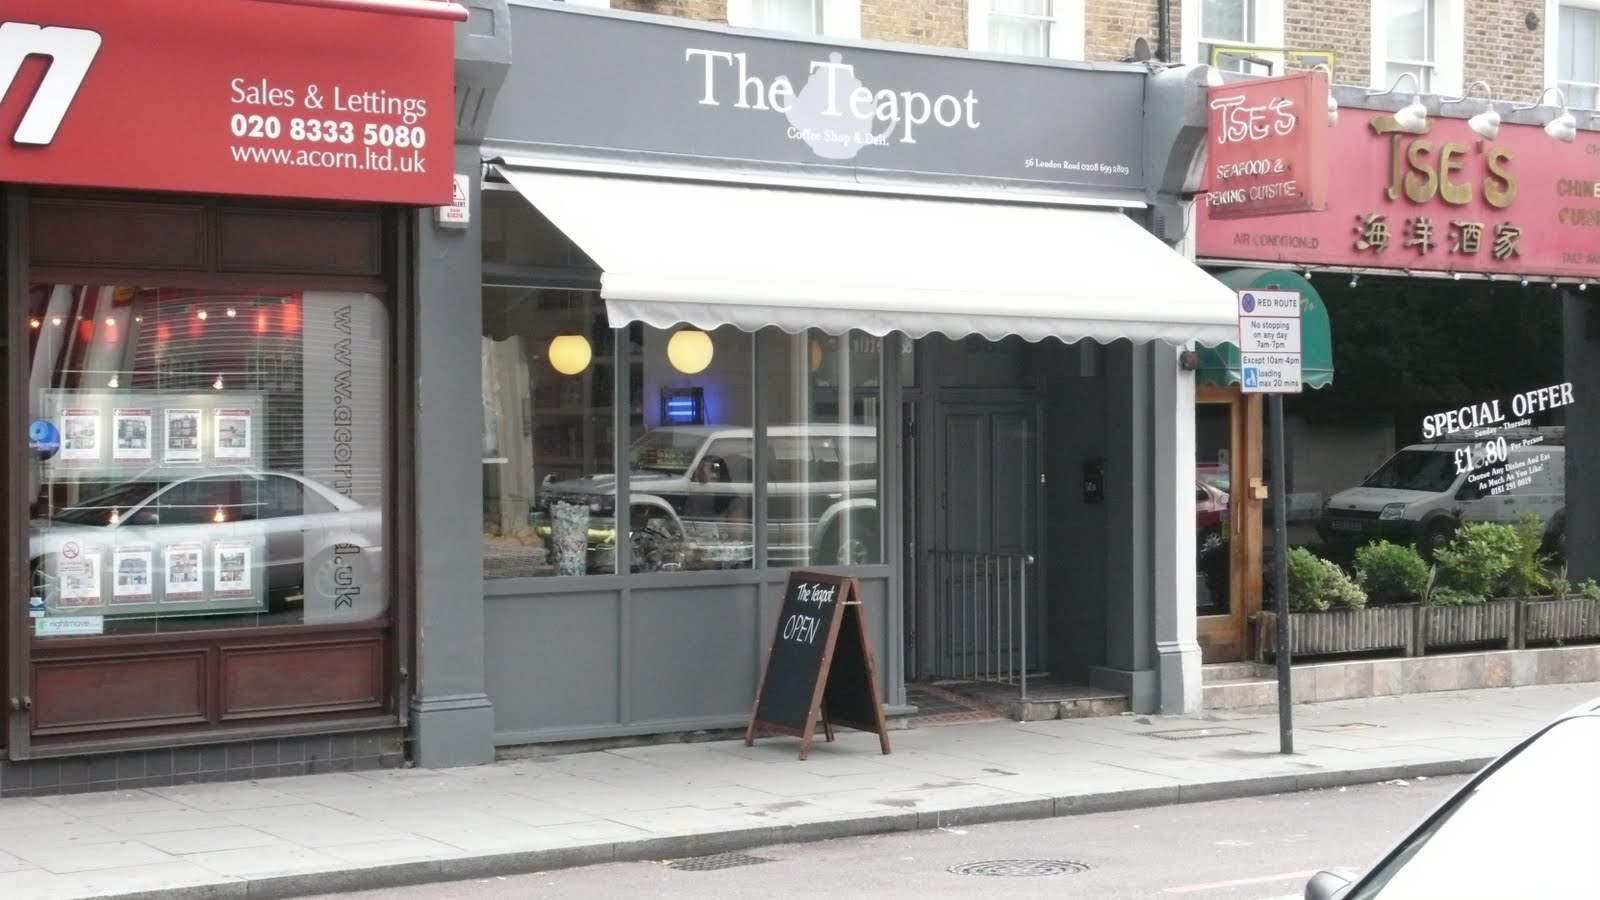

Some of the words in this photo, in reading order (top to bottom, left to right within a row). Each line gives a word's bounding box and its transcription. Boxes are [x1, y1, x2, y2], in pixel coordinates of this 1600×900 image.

[230, 77, 296, 107] Sales
[303, 84, 324, 110] &
[334, 86, 427, 125] Lettings
[685, 47, 793, 114] The
[809, 60, 981, 144] Teapot
[1210, 95, 1296, 144] TSE'S
[230, 113, 282, 140] 020
[289, 117, 355, 144] 8333
[363, 123, 426, 149] 5080
[787, 126, 821, 141] Coffee
[824, 128, 851, 147] Shop
[230, 145, 427, 174] www.acorn.ltd.uk
[1024, 158, 1034, 169] 56
[1035, 158, 1062, 169] London
[1063, 160, 1081, 170] Road
[1081, 162, 1099, 172] 0208
[1099, 163, 1112, 174] 699
[1112, 164, 1130, 175] 2829
[1216, 159, 1270, 179] SEAFOOD
[1369, 116, 1518, 209] TSE'S
[1206, 188, 1246, 207] PEKING
[1233, 232, 1250, 246] AIR
[1252, 233, 1320, 249] CONDITIONED
[1352, 212, 1523, 261] 海洋酒家
[1257, 298, 1272, 307] RED
[1274, 299, 1298, 308] ROUTE
[1251, 320, 1261, 329] No
[1262, 321, 1290, 331] stopping
[1263, 332, 1275, 340] any
[1276, 331, 1288, 340] day
[1256, 340, 1286, 350] 7am-7pm
[1243, 355, 1266, 366] Except
[1258, 369, 1282, 379] loading
[1258, 380, 1272, 388] max
[1273, 379, 1282, 388] 20
[1283, 379, 1299, 388] mins
[1422, 399, 1505, 439] SPECIAL
[1511, 382, 1575, 418] OFFER
[1474, 426, 1498, 438] Sunday
[1503, 417, 1532, 430] Thursday
[1510, 442, 1522, 451] Per
[1522, 435, 1544, 447] Person
[1468, 470, 1491, 483] Choose
[1491, 467, 1504, 476] Any
[1504, 460, 1526, 472] Dishes
[1527, 454, 1539, 465] And
[1540, 452, 1551, 461] Eat
[1478, 482, 1488, 491] As
[1488, 476, 1505, 487] Much
[1506, 473, 1515, 482] As
[1515, 470, 1528, 479] You
[1505, 481, 1517, 491] 291
[797, 582, 810, 603] The
[810, 582, 836, 610] Teapot
[783, 614, 821, 645] OPEN
